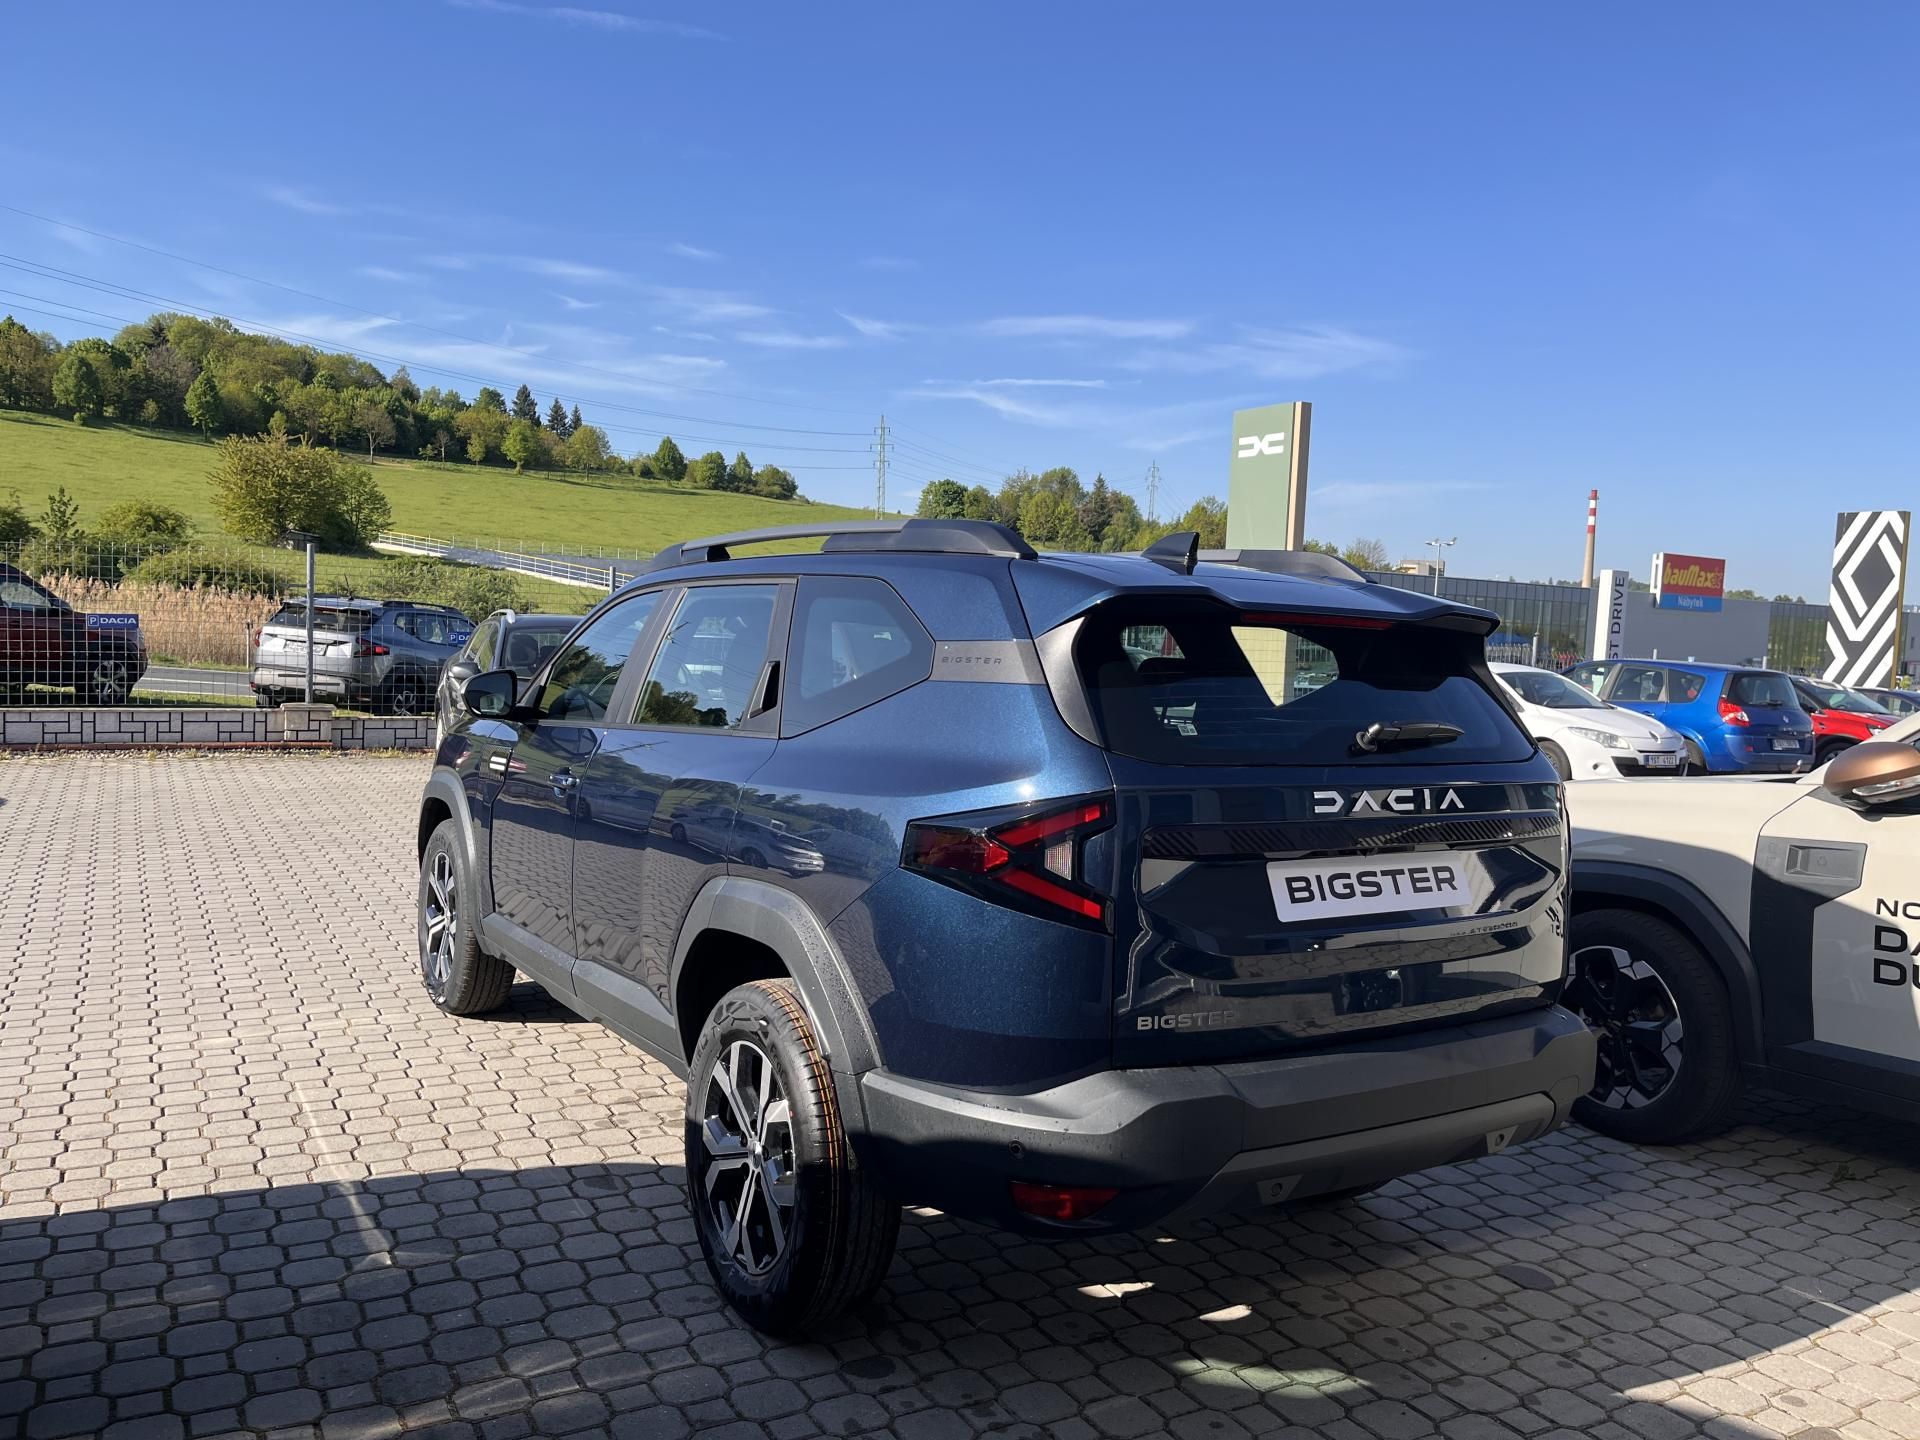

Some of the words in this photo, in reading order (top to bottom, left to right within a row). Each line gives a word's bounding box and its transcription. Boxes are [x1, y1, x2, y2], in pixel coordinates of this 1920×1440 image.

[1611, 576, 1625, 634] DRIVE
[942, 656, 1002, 665] BIGSTER
[1313, 788, 1465, 813] DACIA
[1285, 865, 1458, 904] BIGSTER
